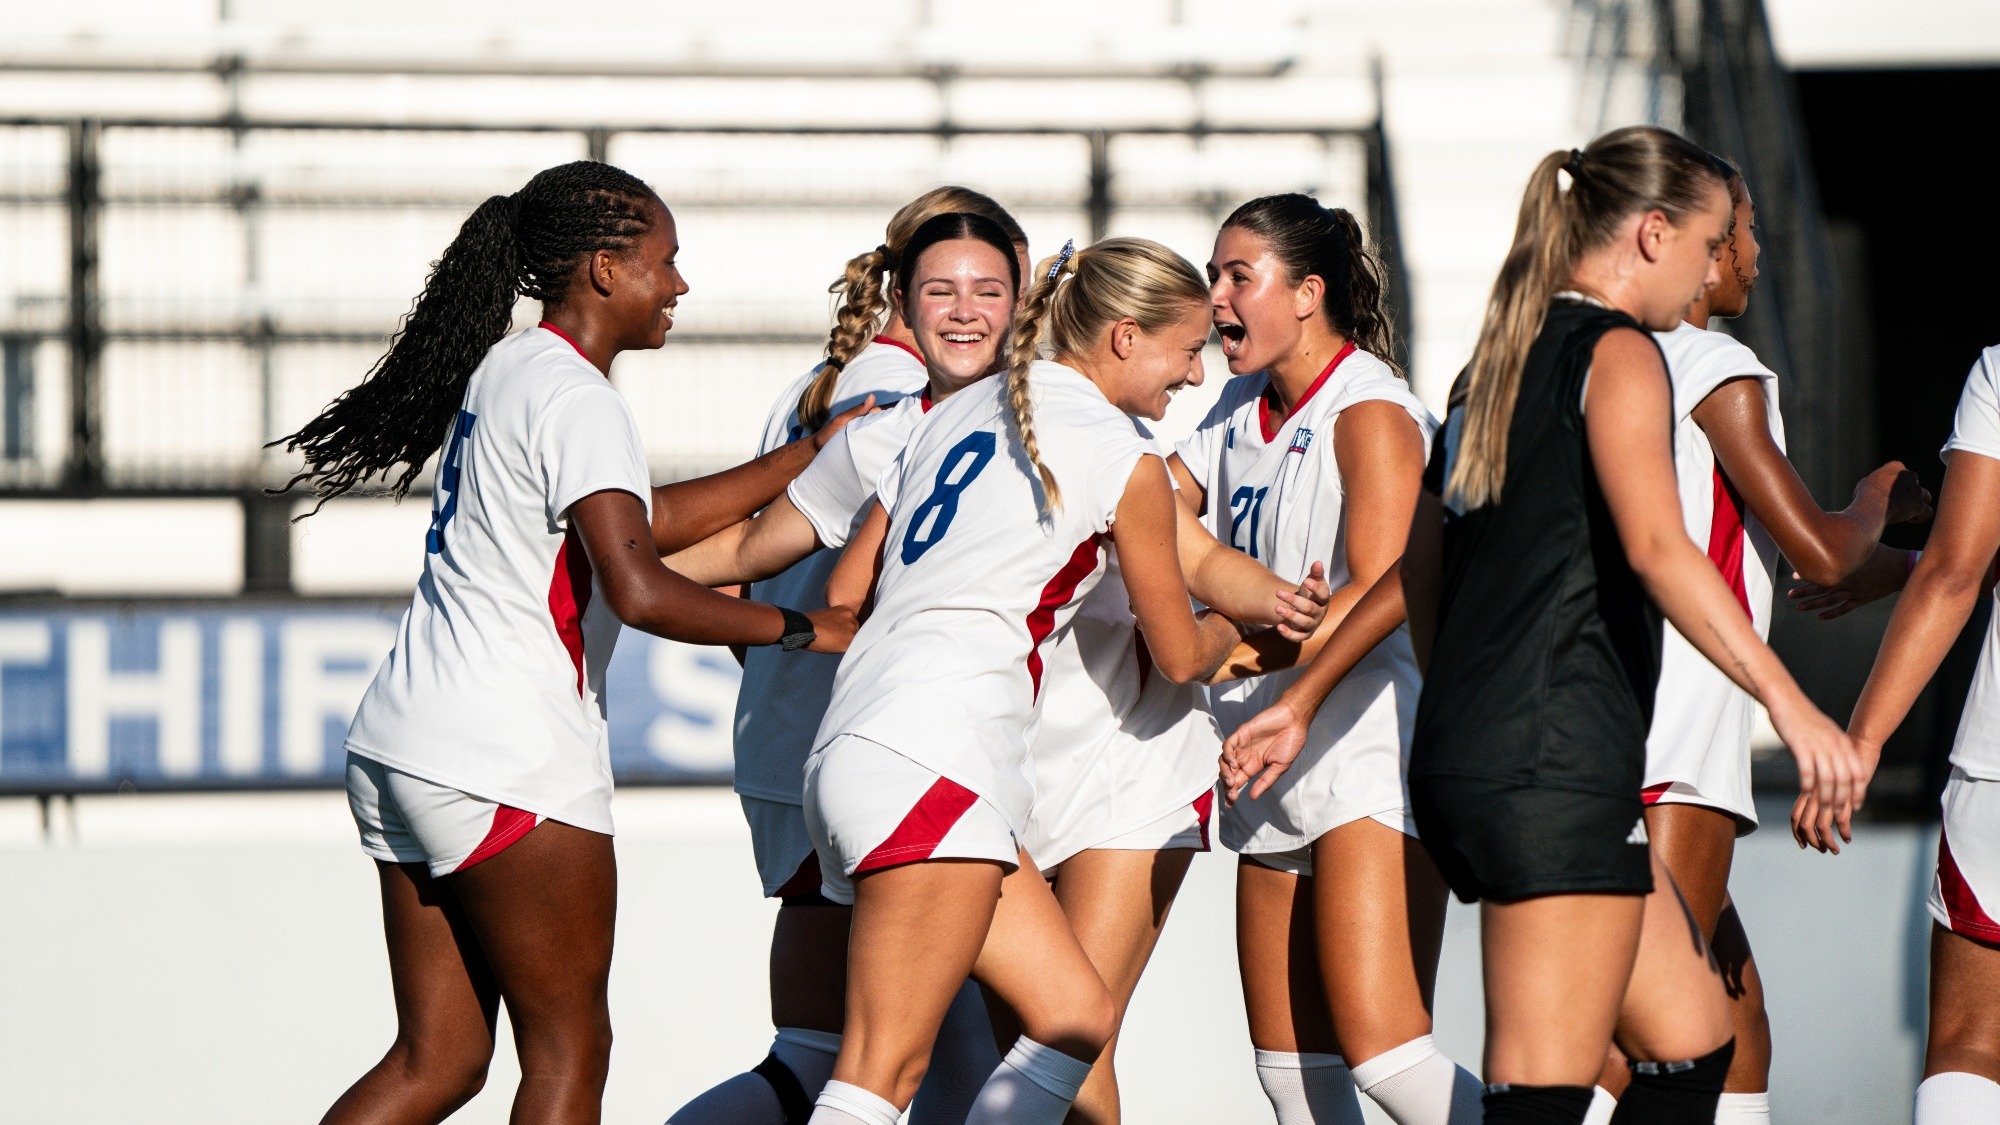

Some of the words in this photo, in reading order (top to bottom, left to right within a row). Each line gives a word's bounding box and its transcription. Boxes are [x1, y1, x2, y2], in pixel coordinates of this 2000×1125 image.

[426, 409, 477, 554] 5
[900, 430, 996, 566] 8
[1230, 485, 1270, 559] 21
